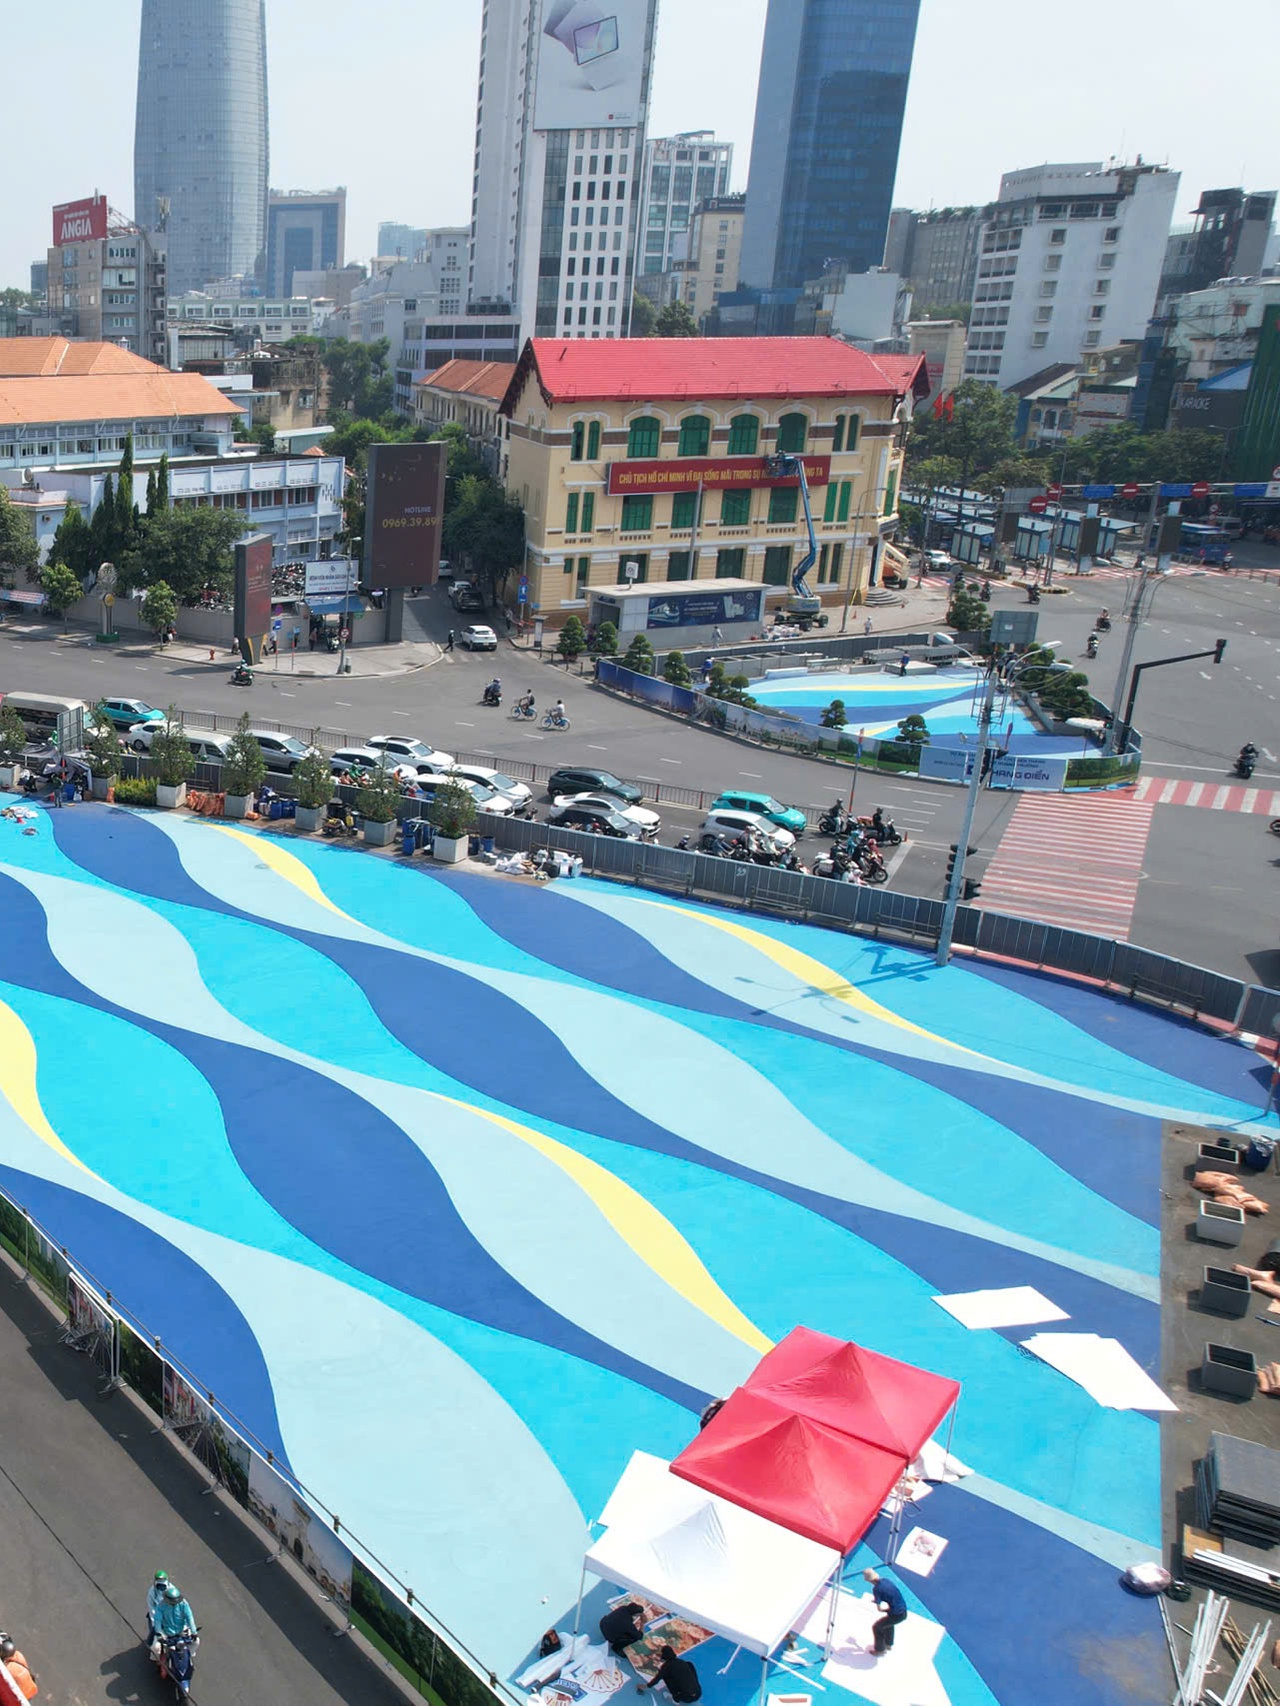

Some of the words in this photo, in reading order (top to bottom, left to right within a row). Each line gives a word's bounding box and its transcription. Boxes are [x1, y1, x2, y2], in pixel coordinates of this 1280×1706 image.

[1180, 398, 1211, 410] KARAOKE
[669, 471, 686, 482] MINH
[703, 468, 719, 481] SỐNG
[732, 469, 752, 480] TRONG
[404, 506, 432, 514] HOTLINE
